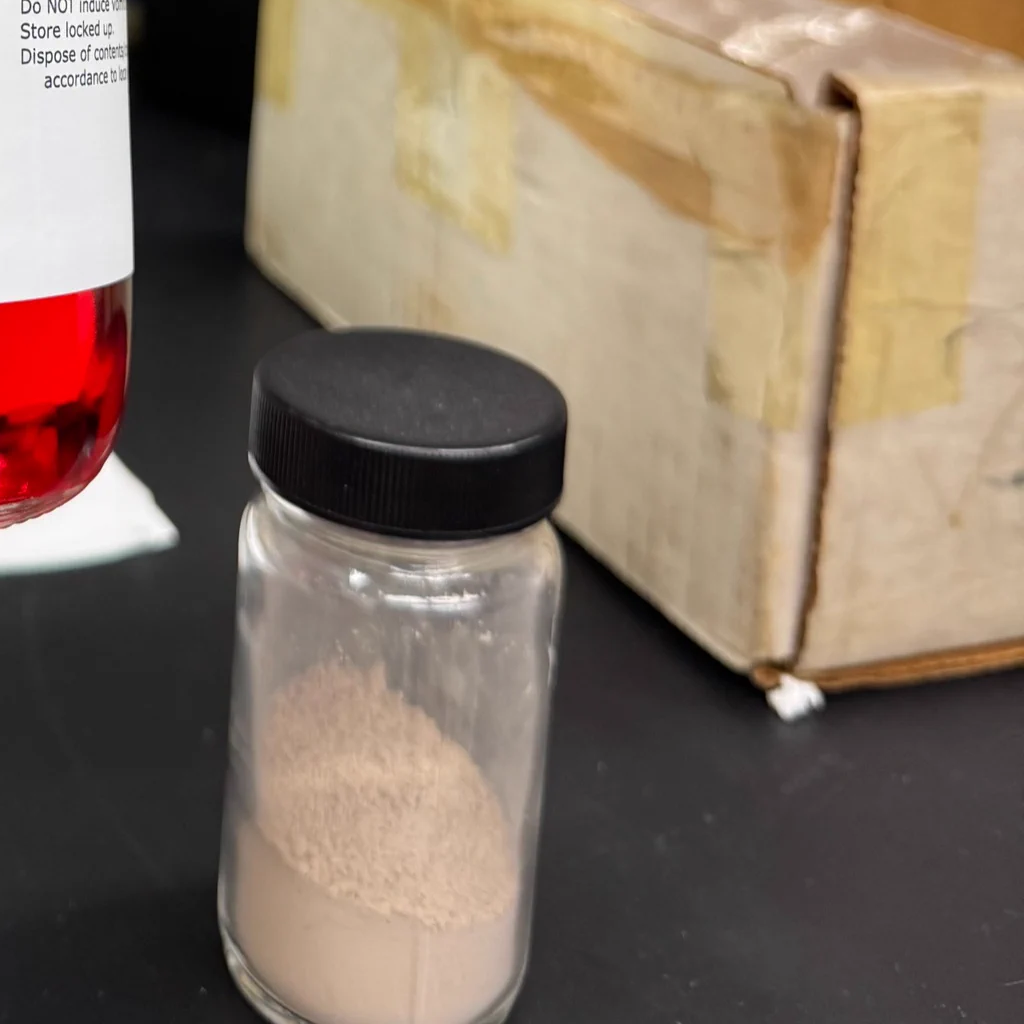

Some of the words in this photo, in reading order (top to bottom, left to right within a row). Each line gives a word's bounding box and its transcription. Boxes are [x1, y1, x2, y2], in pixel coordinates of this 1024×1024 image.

[20, 23, 61, 39] Store
[65, 20, 100, 38] locked
[103, 22, 114, 39] up.
[20, 48, 76, 67] Dispose
[80, 44, 91, 62] of
[44, 68, 108, 89] accordance
[110, 68, 117, 83] to
